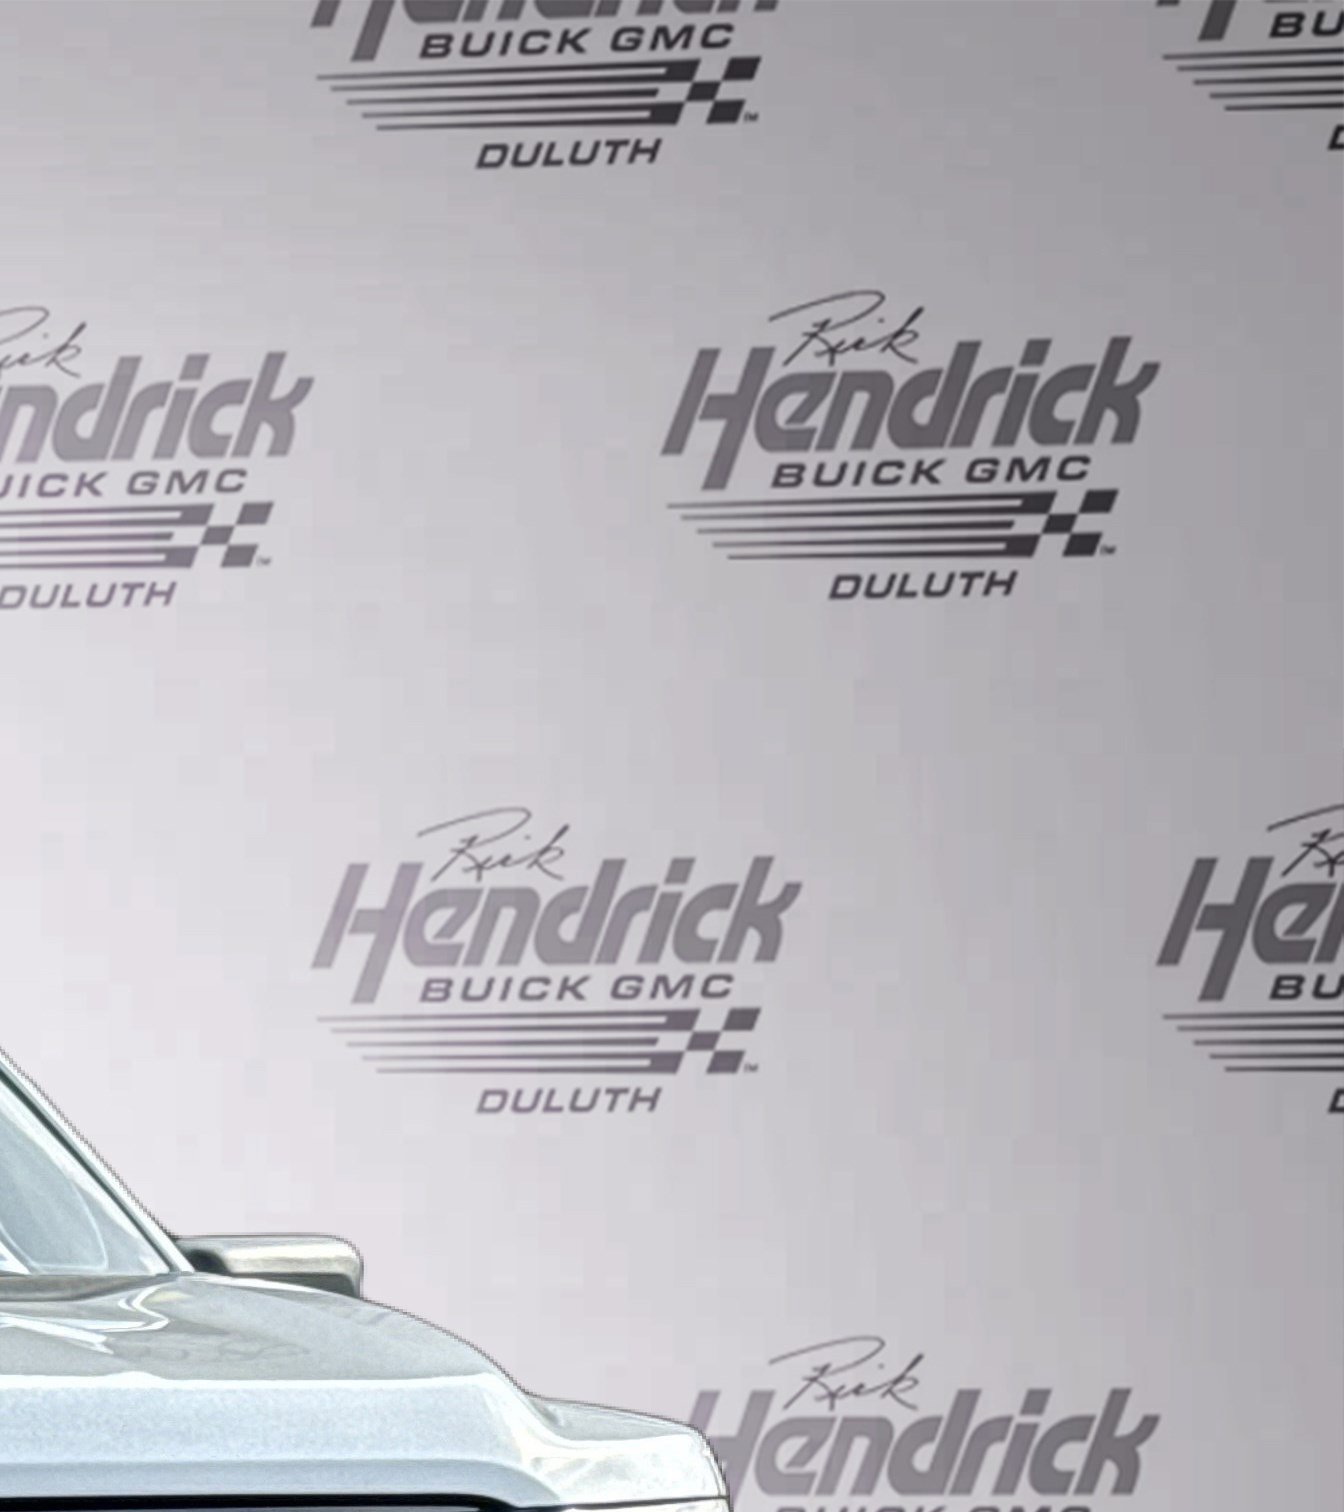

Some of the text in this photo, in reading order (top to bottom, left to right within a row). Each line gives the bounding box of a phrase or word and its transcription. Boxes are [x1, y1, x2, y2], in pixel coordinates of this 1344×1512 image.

[420, 23, 734, 59] BUICK GMC
[476, 138, 662, 169] DULUTH
[661, 336, 1160, 490] Hendrick
[127, 469, 247, 495] GMC
[771, 456, 1091, 488] BUICK GMC
[829, 571, 1018, 600] DULUTH
[312, 856, 802, 1003] Hendrick
[420, 974, 734, 1002] BUICK GMC
[477, 1087, 662, 1113] DULUTH
